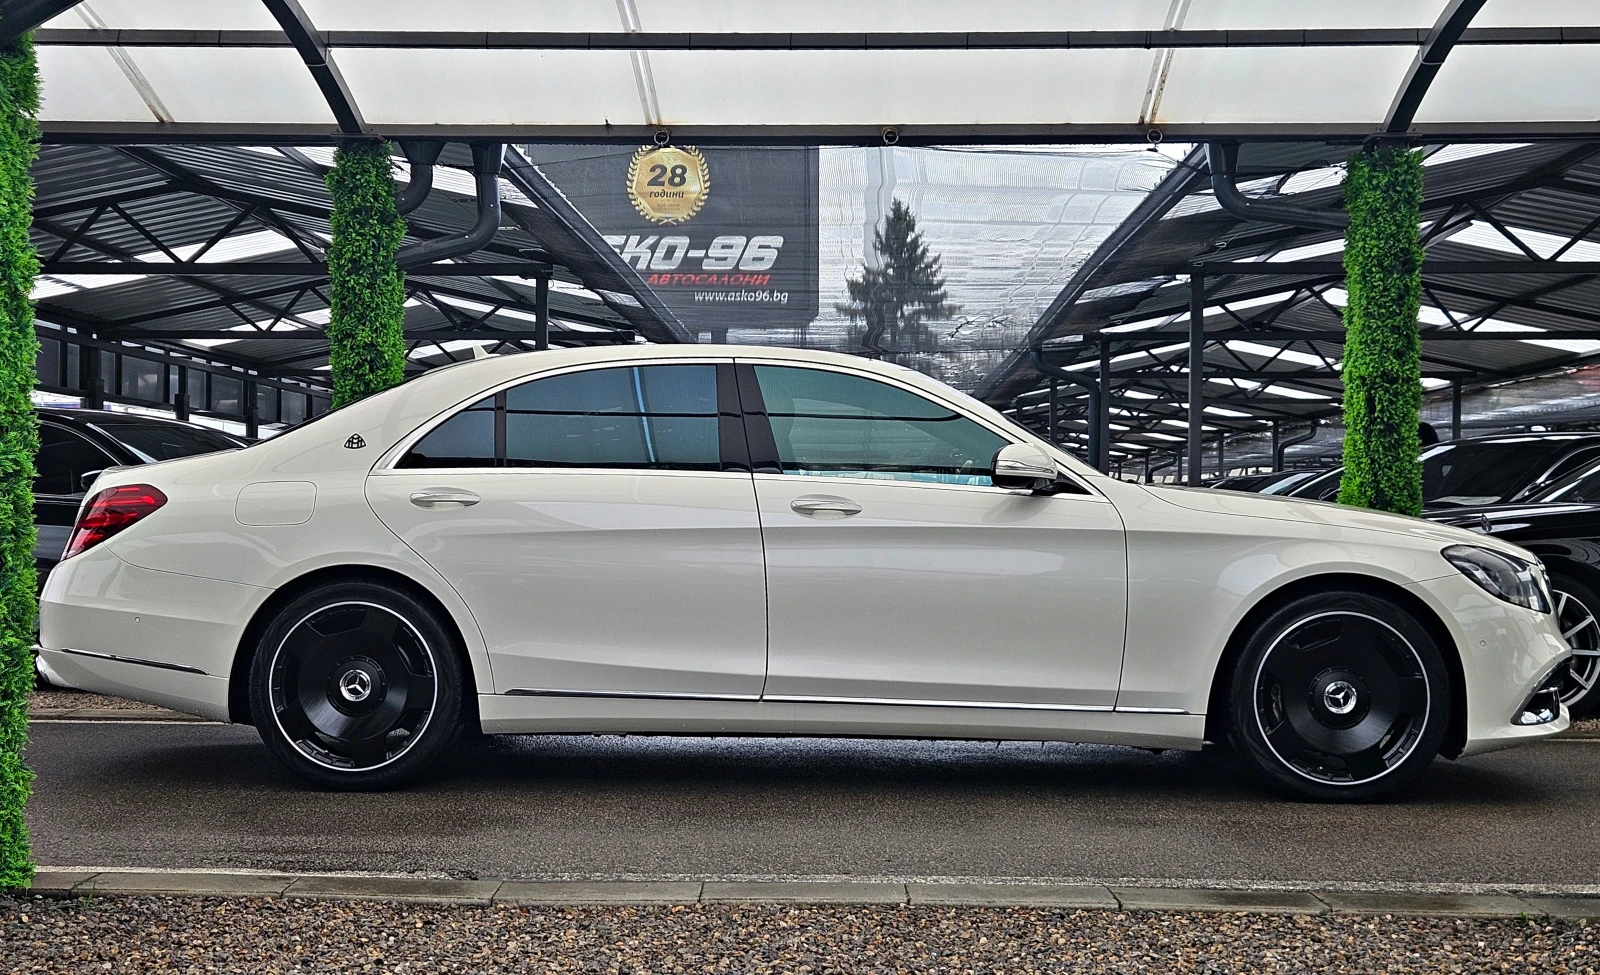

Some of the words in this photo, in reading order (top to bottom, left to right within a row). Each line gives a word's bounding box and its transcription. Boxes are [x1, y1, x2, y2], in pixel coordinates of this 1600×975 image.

[647, 163, 687, 187] 28
[649, 189, 684, 198] години
[646, 274, 770, 286] АВТОСАЛОНИ
[694, 289, 789, 304] www.asko96.bg
